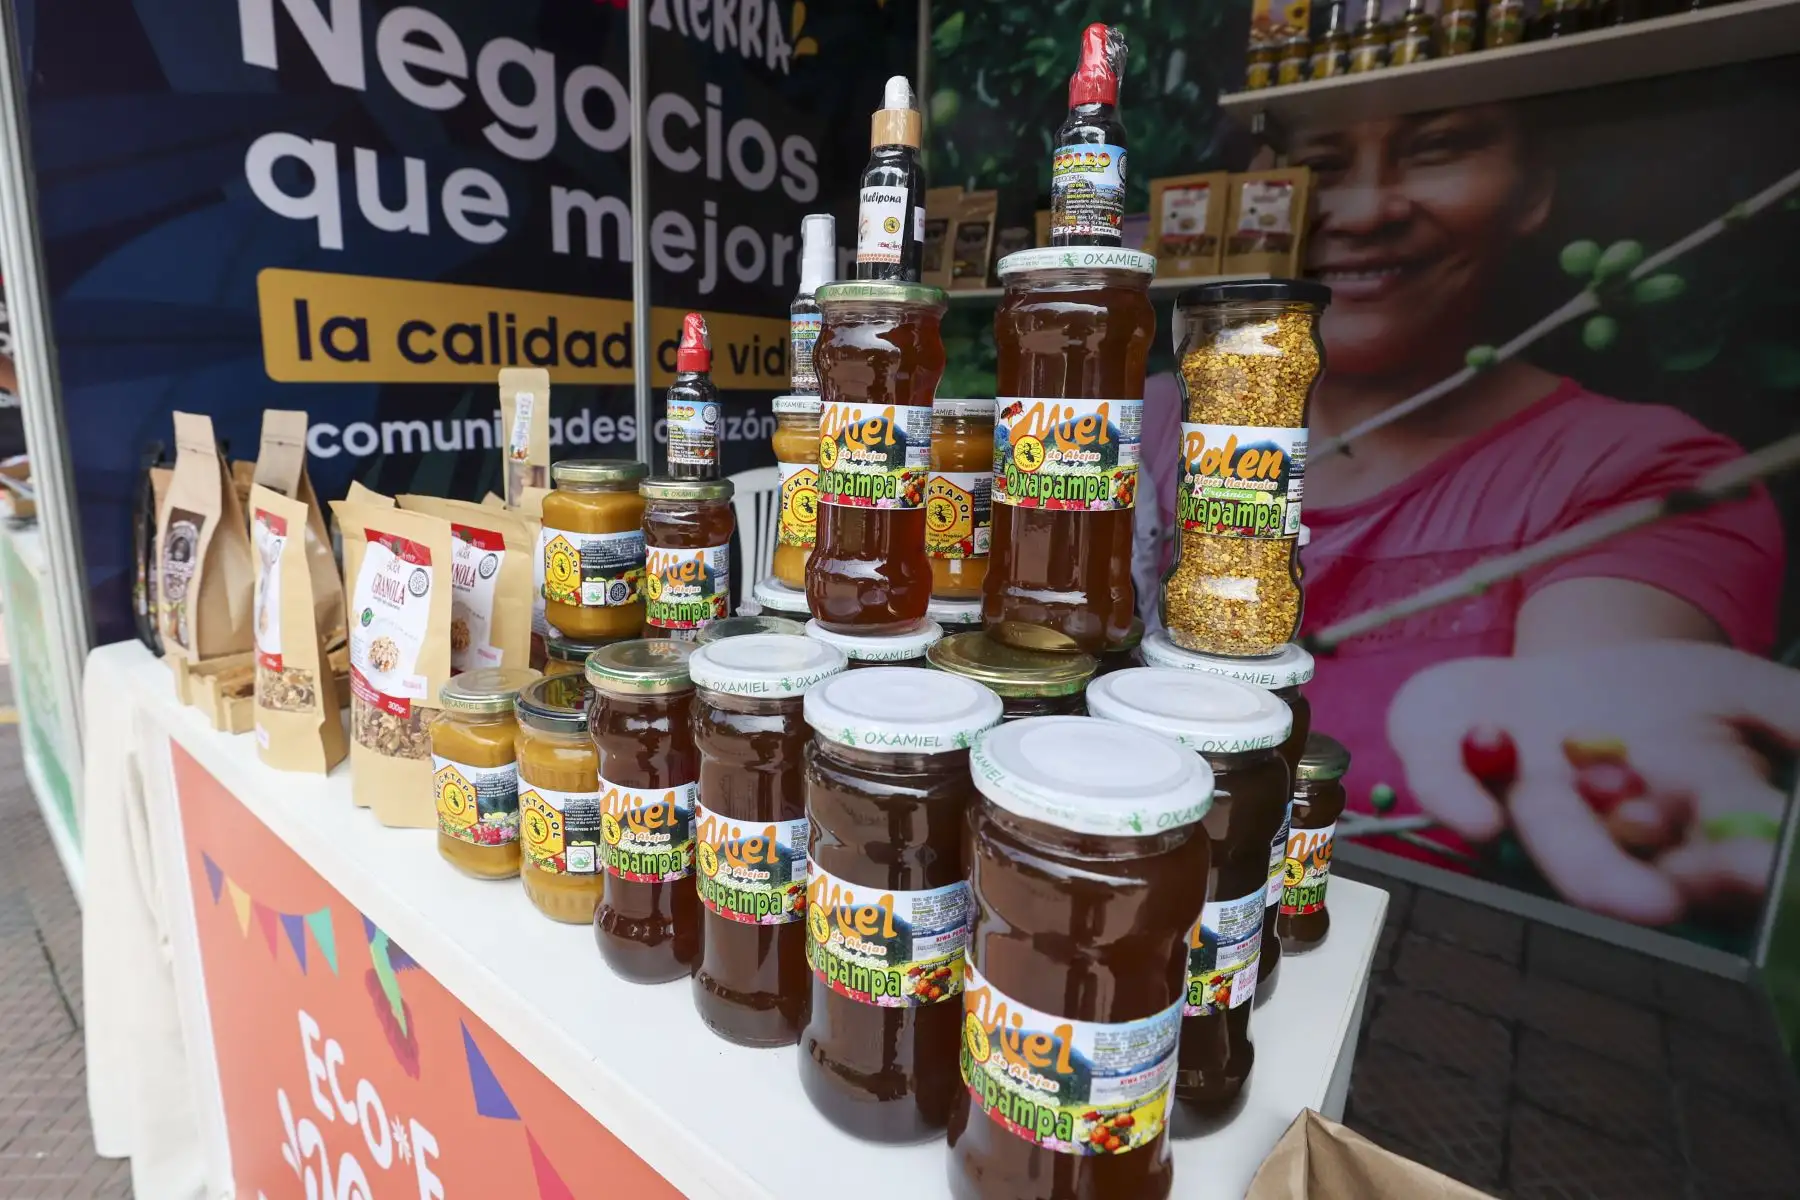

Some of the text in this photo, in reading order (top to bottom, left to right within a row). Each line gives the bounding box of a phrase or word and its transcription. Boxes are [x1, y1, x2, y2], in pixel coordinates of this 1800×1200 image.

[238, 0, 820, 203] Negocios
[1055, 152, 1111, 169] POLEO
[245, 131, 510, 250] que
[861, 193, 902, 205] Melipona
[1084, 254, 1143, 268] OXAMIEL
[293, 298, 370, 362] la
[397, 311, 634, 369] calidad
[657, 328, 714, 374] d
[728, 334, 792, 376] vid
[306, 405, 636, 458] comuniades
[820, 403, 896, 451] Miel
[1009, 402, 1110, 454] Miel
[840, 449, 887, 463] de Abejas
[1046, 449, 1101, 463] de Abejas
[1185, 431, 1284, 480] Polen
[783, 477, 818, 510] NECKTA
[820, 470, 897, 504] xapampa
[1007, 464, 1110, 508] Oxapampa
[1225, 477, 1279, 491] Naturales
[1180, 488, 1282, 536] Oxapampa
[546, 541, 579, 575] NECKTAPOL
[647, 551, 707, 588] Miel
[371, 573, 406, 606] GRANOLA
[647, 600, 711, 624] xapampa
[866, 649, 915, 661] OXAMIEL
[713, 682, 769, 693] OXAMIEL
[795, 667, 843, 688] OXAMIEL
[1207, 667, 1278, 686] OXAMIEL
[864, 732, 944, 748] OXAMIEL
[1201, 736, 1275, 753] OXAMIEL
[600, 788, 679, 834] Miel
[623, 832, 671, 843] de Abejas
[700, 817, 779, 868] Miel
[1288, 832, 1334, 869] Mie
[720, 864, 770, 880] de Abejas
[808, 874, 898, 939] Miel
[831, 930, 888, 956] de Abejas
[965, 985, 1075, 1075] Miel
[993, 1052, 1060, 1092] de Abejas
